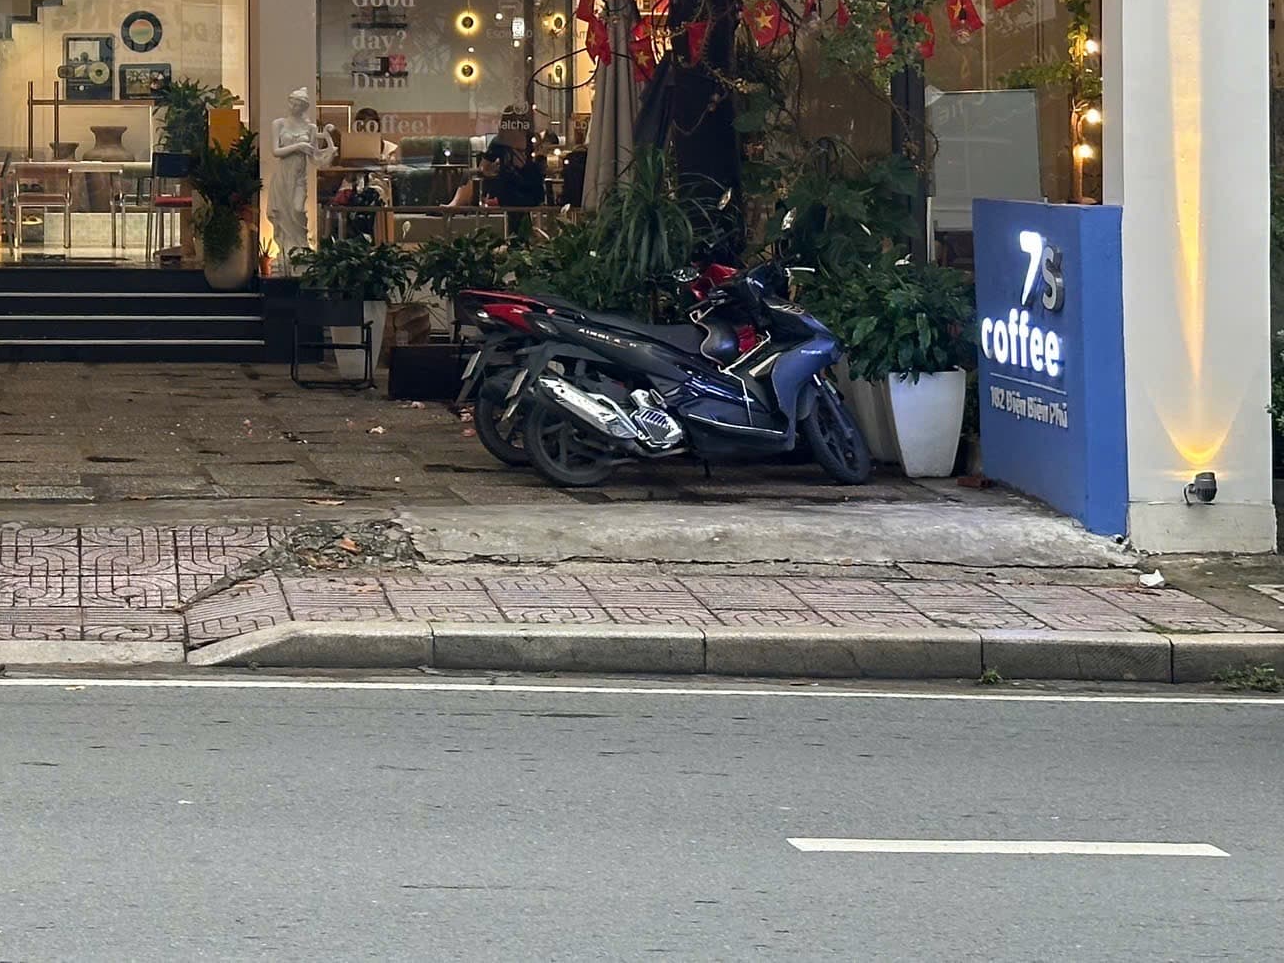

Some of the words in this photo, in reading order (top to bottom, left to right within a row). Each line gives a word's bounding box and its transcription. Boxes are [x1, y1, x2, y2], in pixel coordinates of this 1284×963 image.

[351, 29, 408, 54] day?
[352, 72, 410, 90] Drin
[352, 114, 433, 134] coffee!
[981, 308, 1061, 377] coffee
